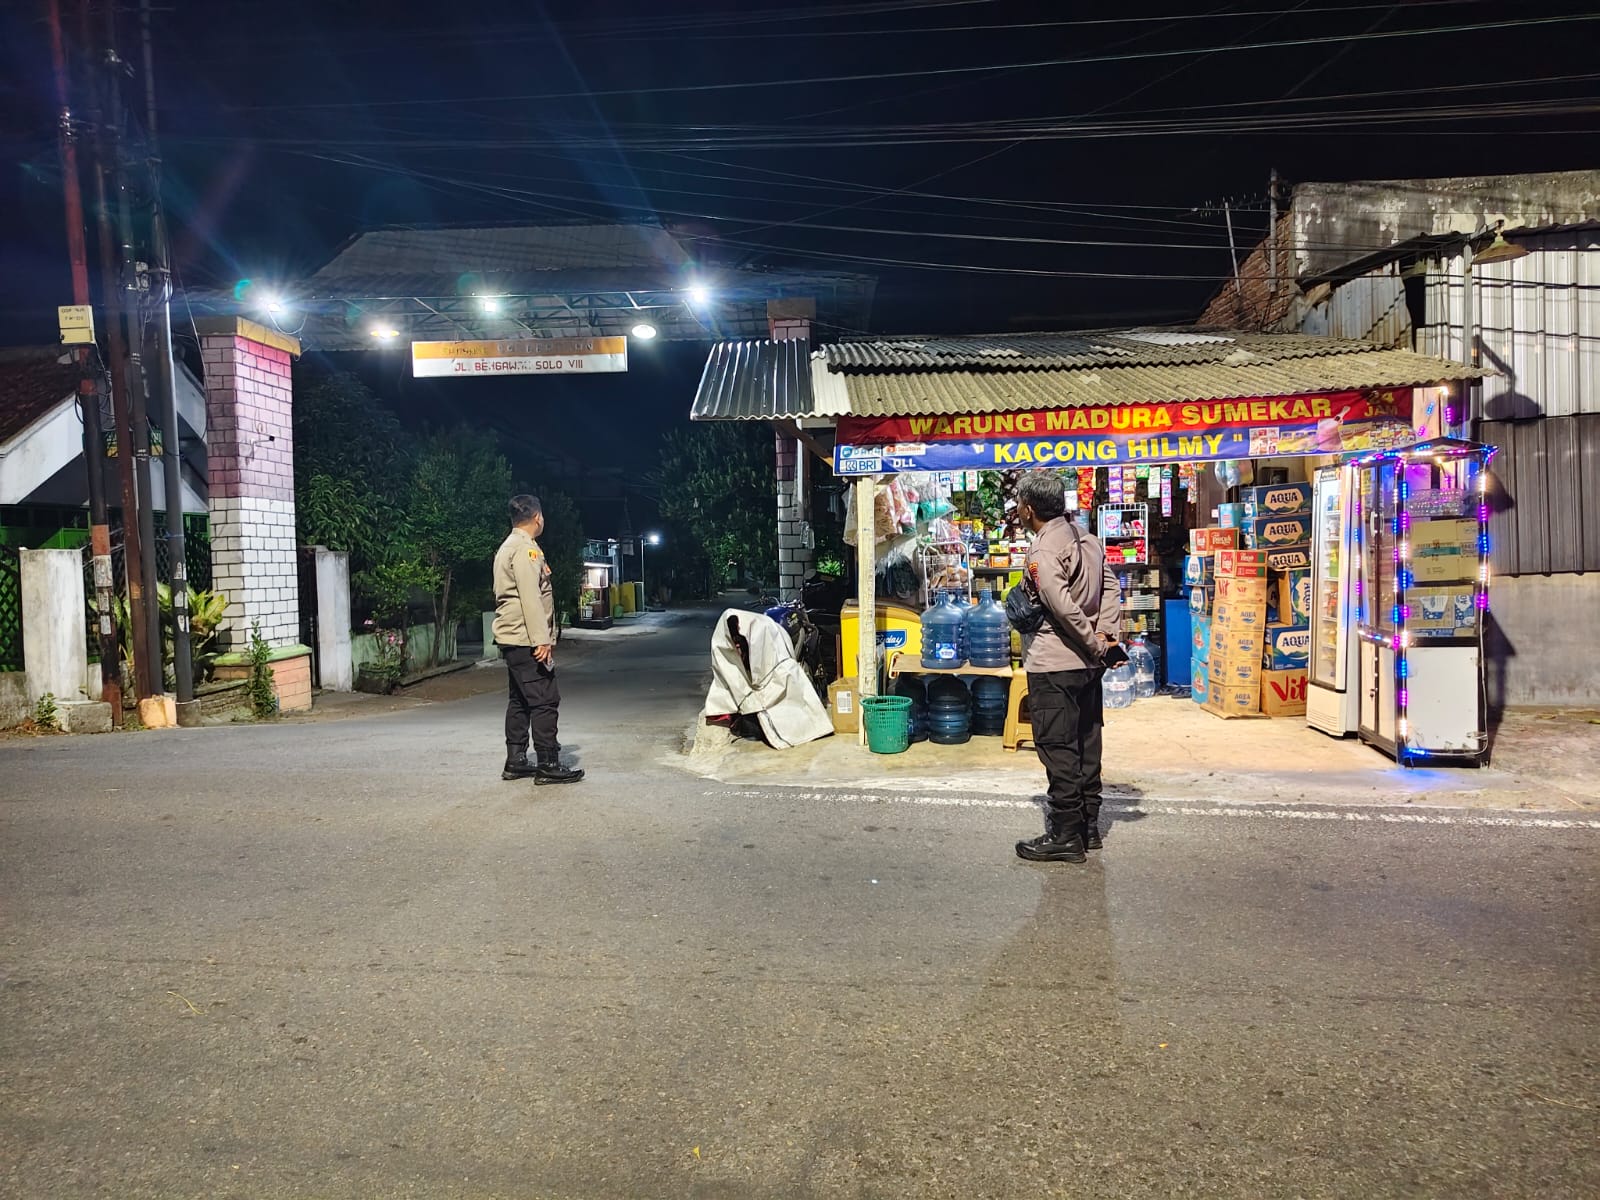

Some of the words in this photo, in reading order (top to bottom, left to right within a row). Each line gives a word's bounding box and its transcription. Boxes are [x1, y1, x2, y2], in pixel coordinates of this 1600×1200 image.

[536, 360, 562, 370] SOLO
[568, 359, 583, 369] VIII
[909, 413, 1036, 435] WARUNG
[1046, 405, 1173, 431] MADURA
[1182, 398, 1332, 425] SUMEKAR
[1364, 404, 1398, 418] JAM
[994, 439, 1118, 464] KACONG
[1128, 434, 1224, 459] HILMY
[859, 459, 876, 471] BRI
[893, 458, 917, 468] DLL
[1270, 491, 1298, 504] AQUA
[1269, 523, 1298, 536] AQUA
[1272, 554, 1301, 567] AQUA
[1282, 635, 1309, 648] AQUA
[1270, 674, 1309, 702] Vit
